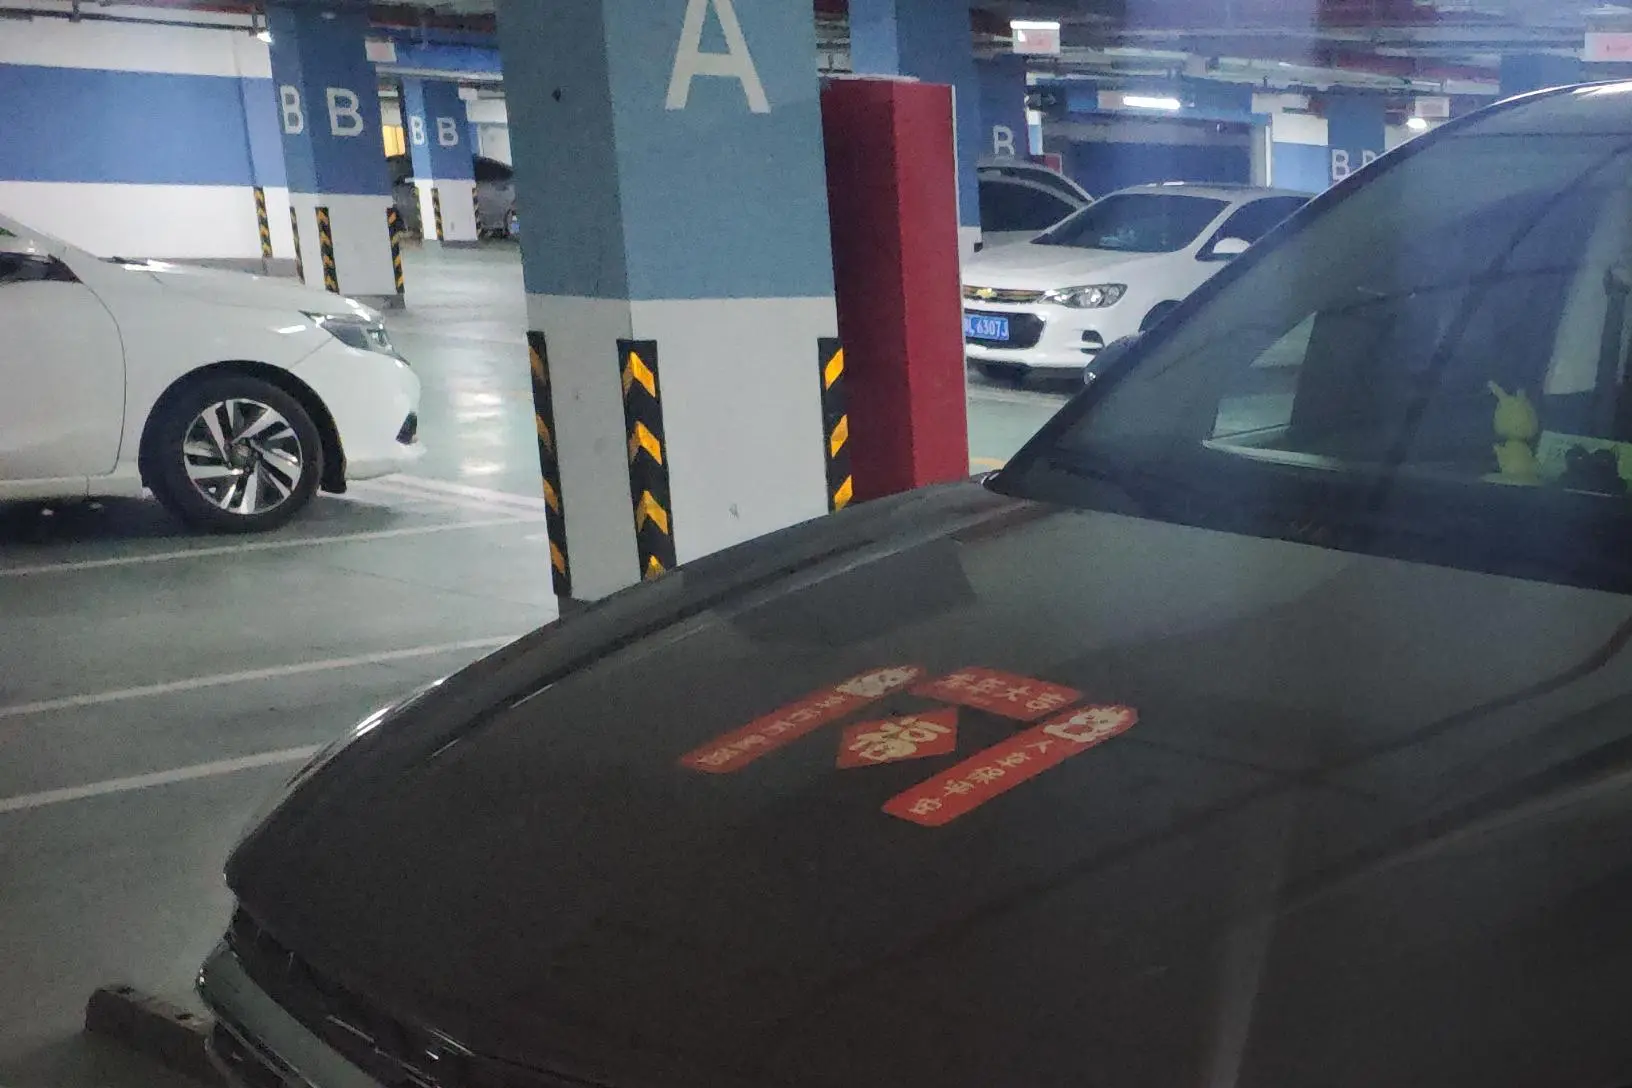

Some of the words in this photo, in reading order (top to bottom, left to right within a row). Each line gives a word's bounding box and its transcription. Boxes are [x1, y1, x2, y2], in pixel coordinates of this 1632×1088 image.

[665, 0, 771, 113] A
[279, 85, 304, 134] B
[326, 87, 364, 136] B
[410, 116, 426, 145] B
[437, 117, 459, 146] B
[1331, 149, 1351, 181] B
[849, 716, 952, 762] 福
